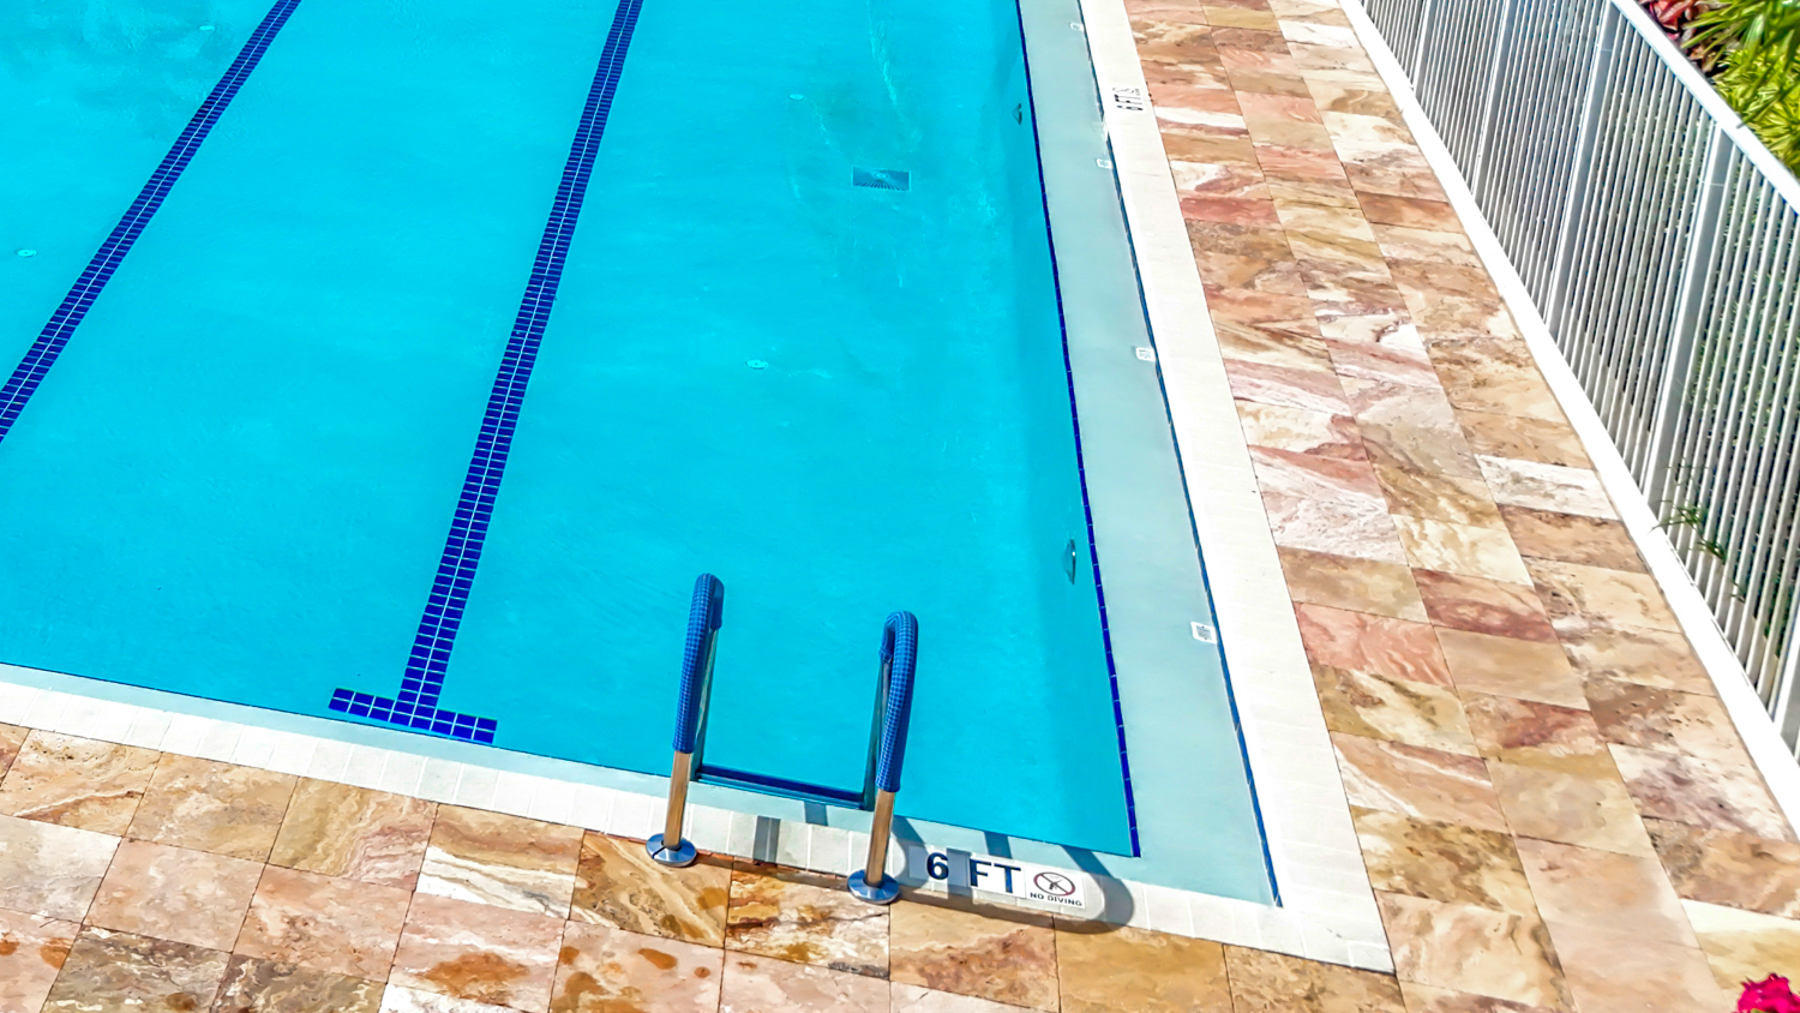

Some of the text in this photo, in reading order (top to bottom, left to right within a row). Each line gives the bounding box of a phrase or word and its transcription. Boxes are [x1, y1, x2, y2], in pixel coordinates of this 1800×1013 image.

[926, 852, 1021, 893] 6 FT
[1030, 892, 1082, 907] NO DIVING
